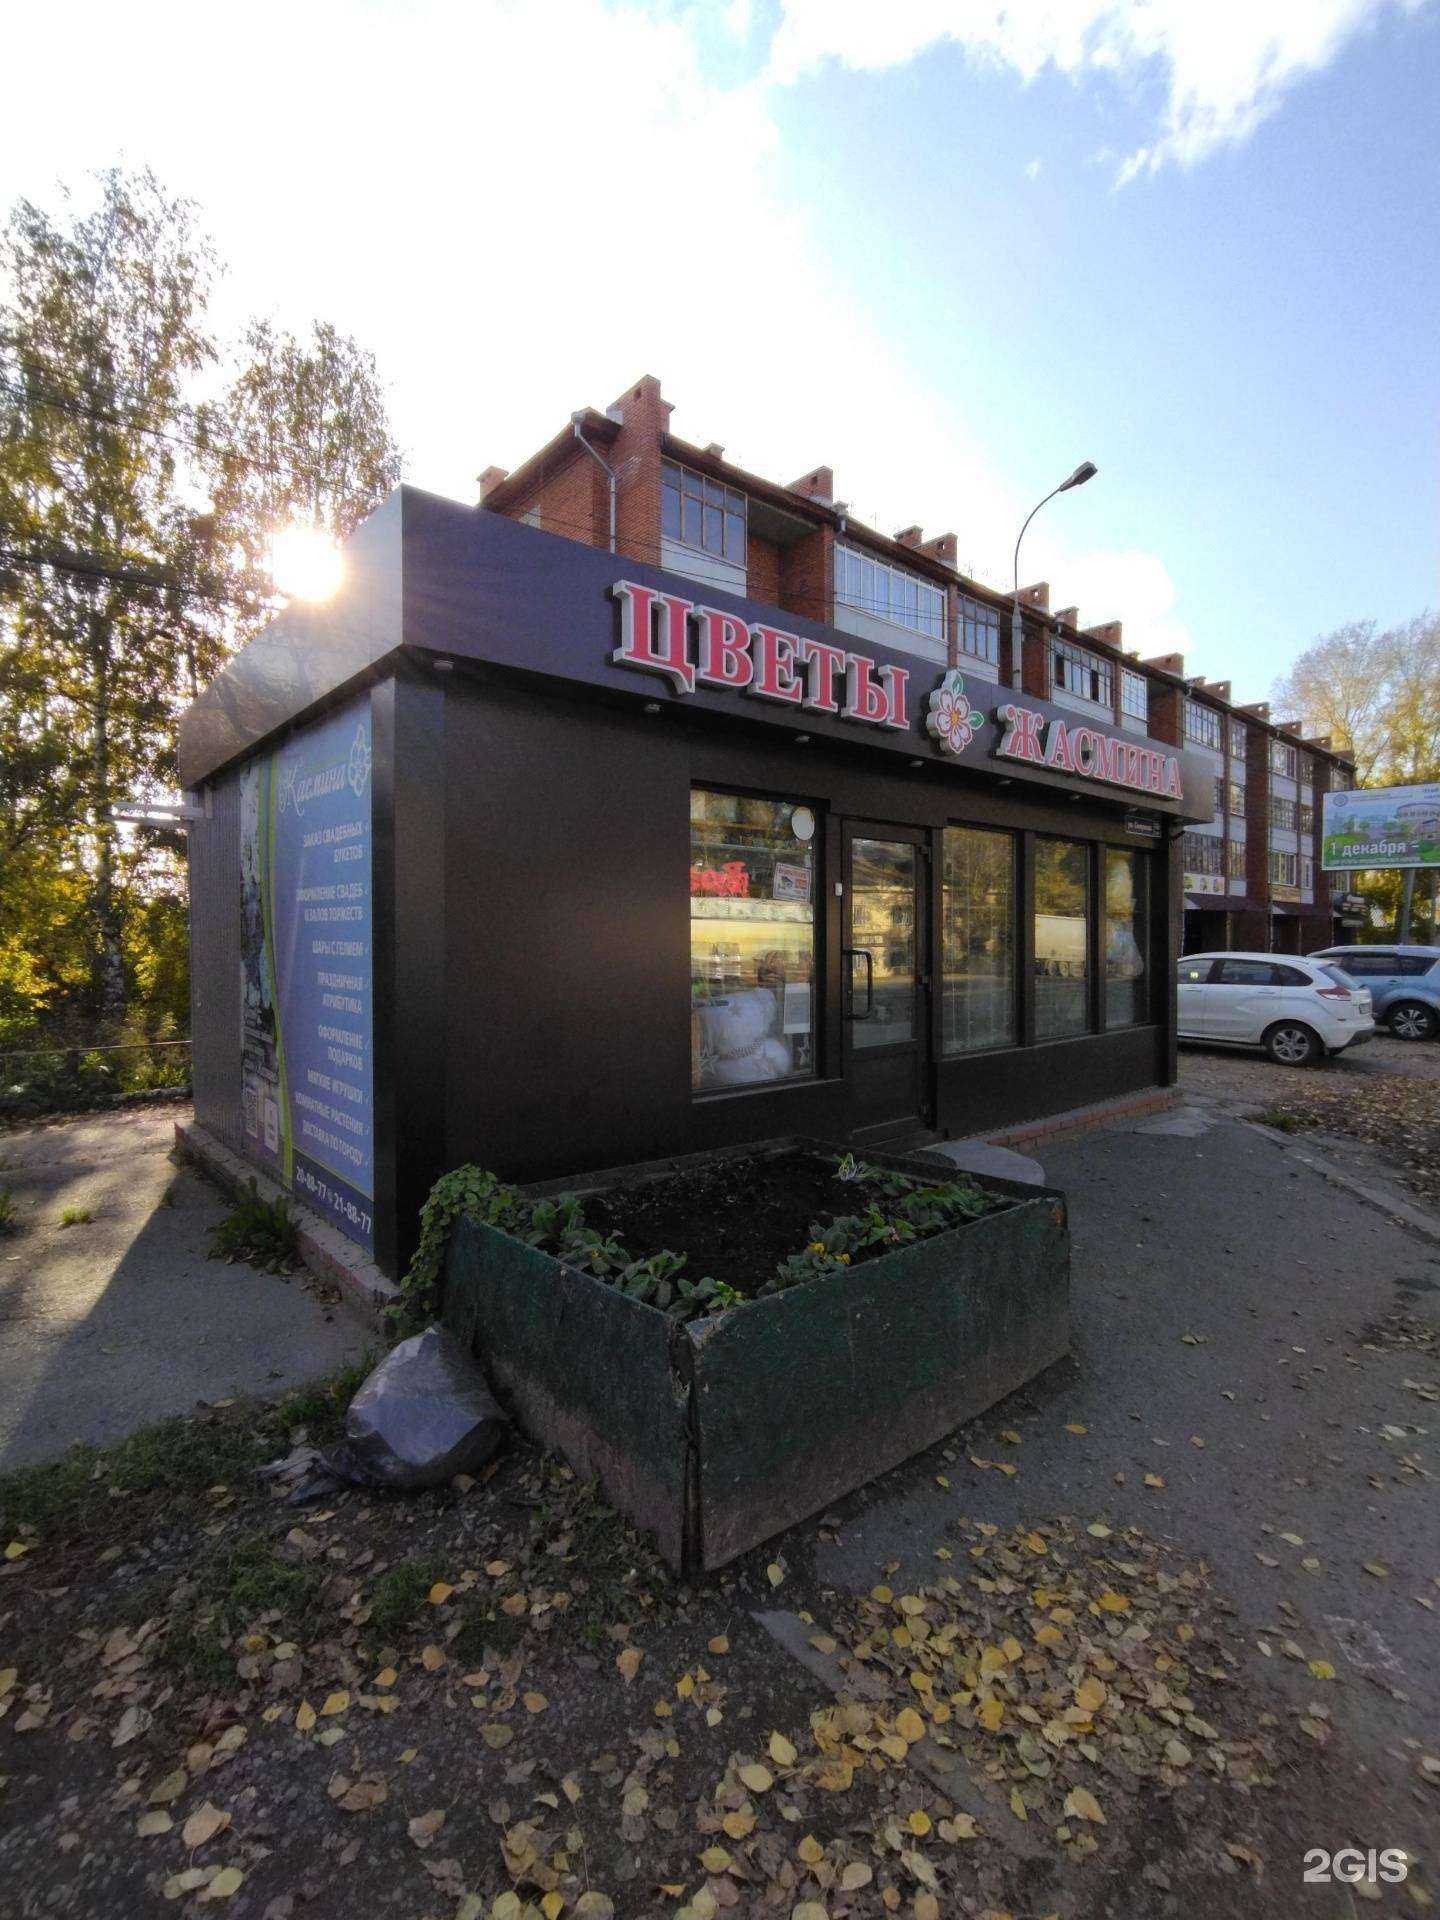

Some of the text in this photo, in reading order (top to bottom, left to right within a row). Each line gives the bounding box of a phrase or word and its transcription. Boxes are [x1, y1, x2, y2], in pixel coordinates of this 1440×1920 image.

[612, 580, 910, 730] ЦВЕТЫ
[997, 703, 1183, 800] ЖАСМИНА
[333, 844, 364, 863] БУКЕТОВ
[1330, 842, 1336, 856] 1
[1342, 839, 1407, 858] декабря
[334, 1192, 372, 1235] 21-88-77
